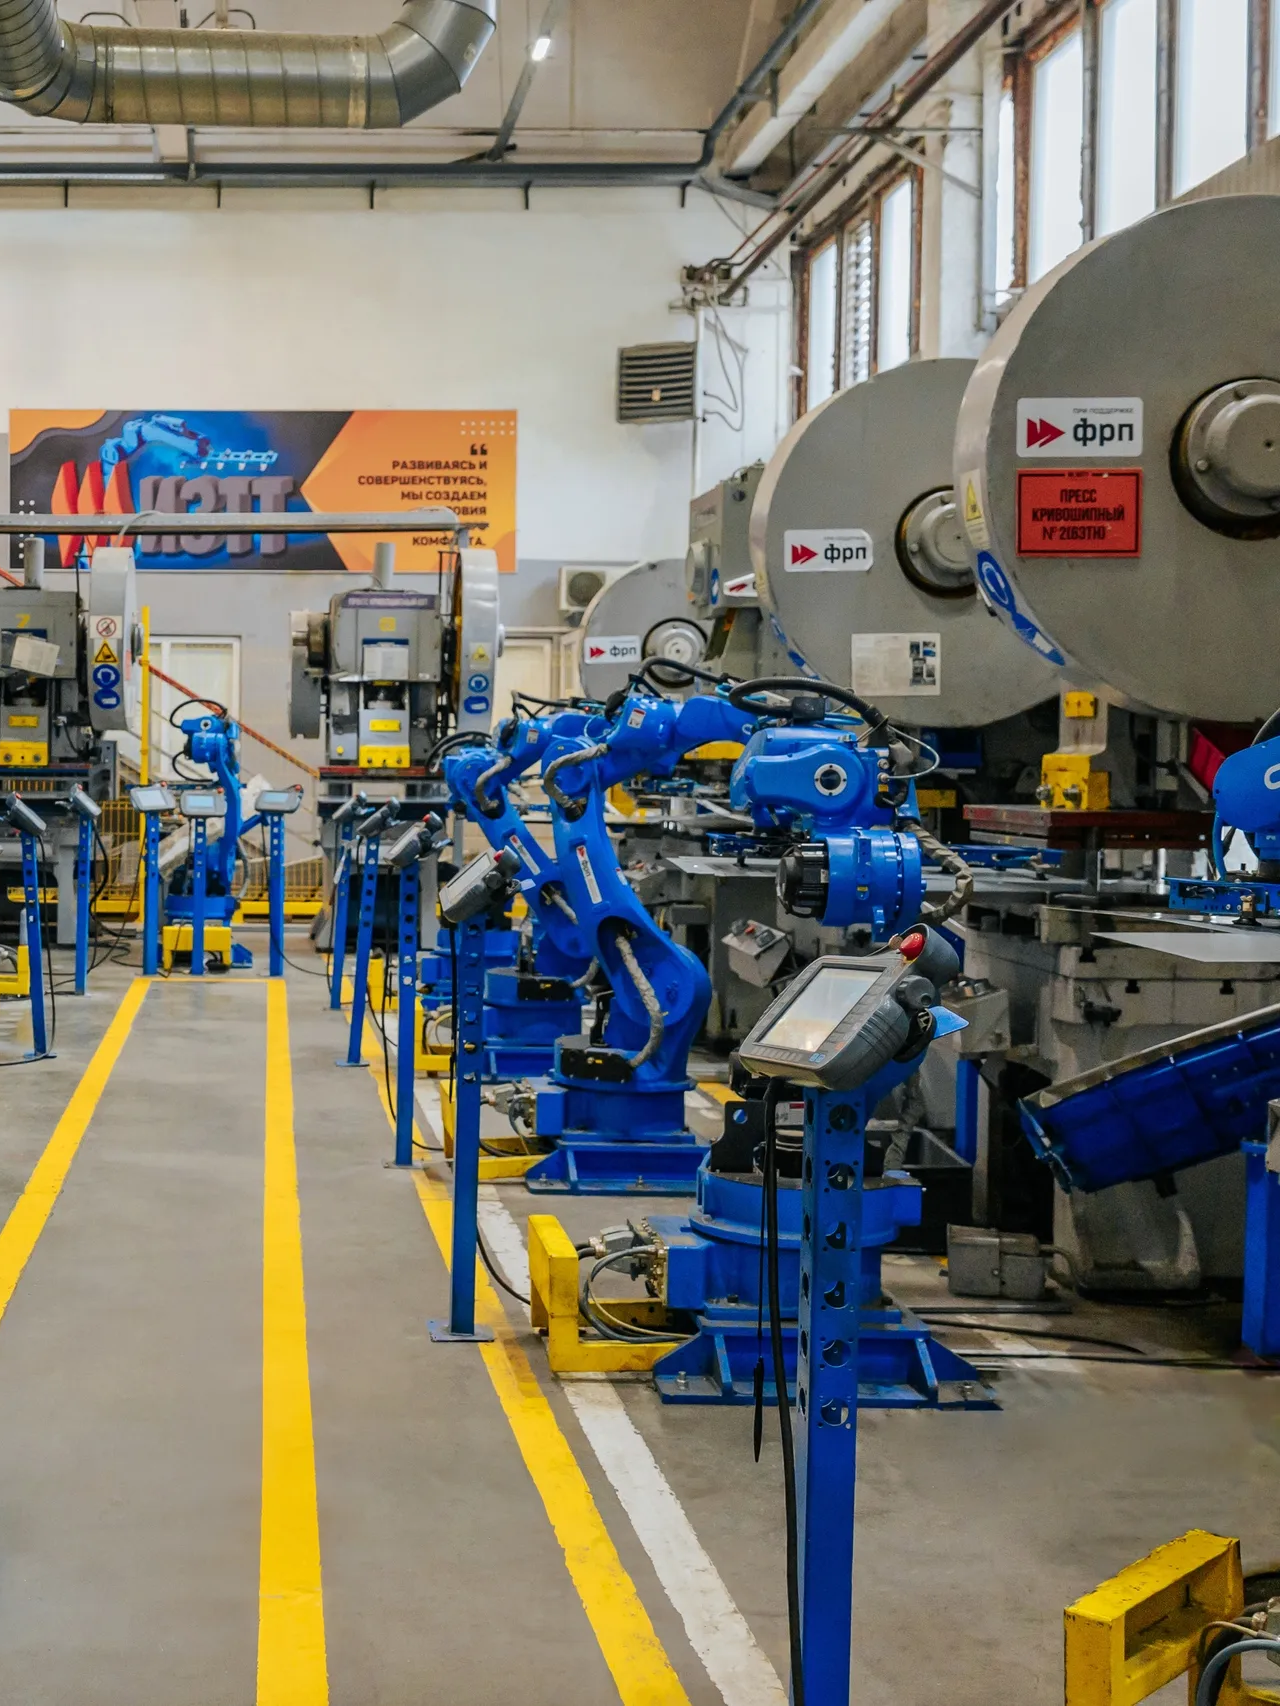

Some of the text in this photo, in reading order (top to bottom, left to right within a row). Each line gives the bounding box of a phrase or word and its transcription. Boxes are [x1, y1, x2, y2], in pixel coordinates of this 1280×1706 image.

[1073, 417, 1134, 447] фрп
[391, 460, 488, 470] РАЗВИВАЯСЬ И
[357, 475, 488, 486] СОВЕРШЕНСТВУЯСЬ,
[400, 491, 487, 502] МЫ СОЗДАЕМ
[1059, 488, 1097, 503] ПРЕСС
[1031, 504, 1125, 522] КРИВОШИПНЫЙ
[412, 535, 487, 546] КОМФТА.
[824, 543, 867, 564] фрп
[609, 644, 637, 658] фрп
